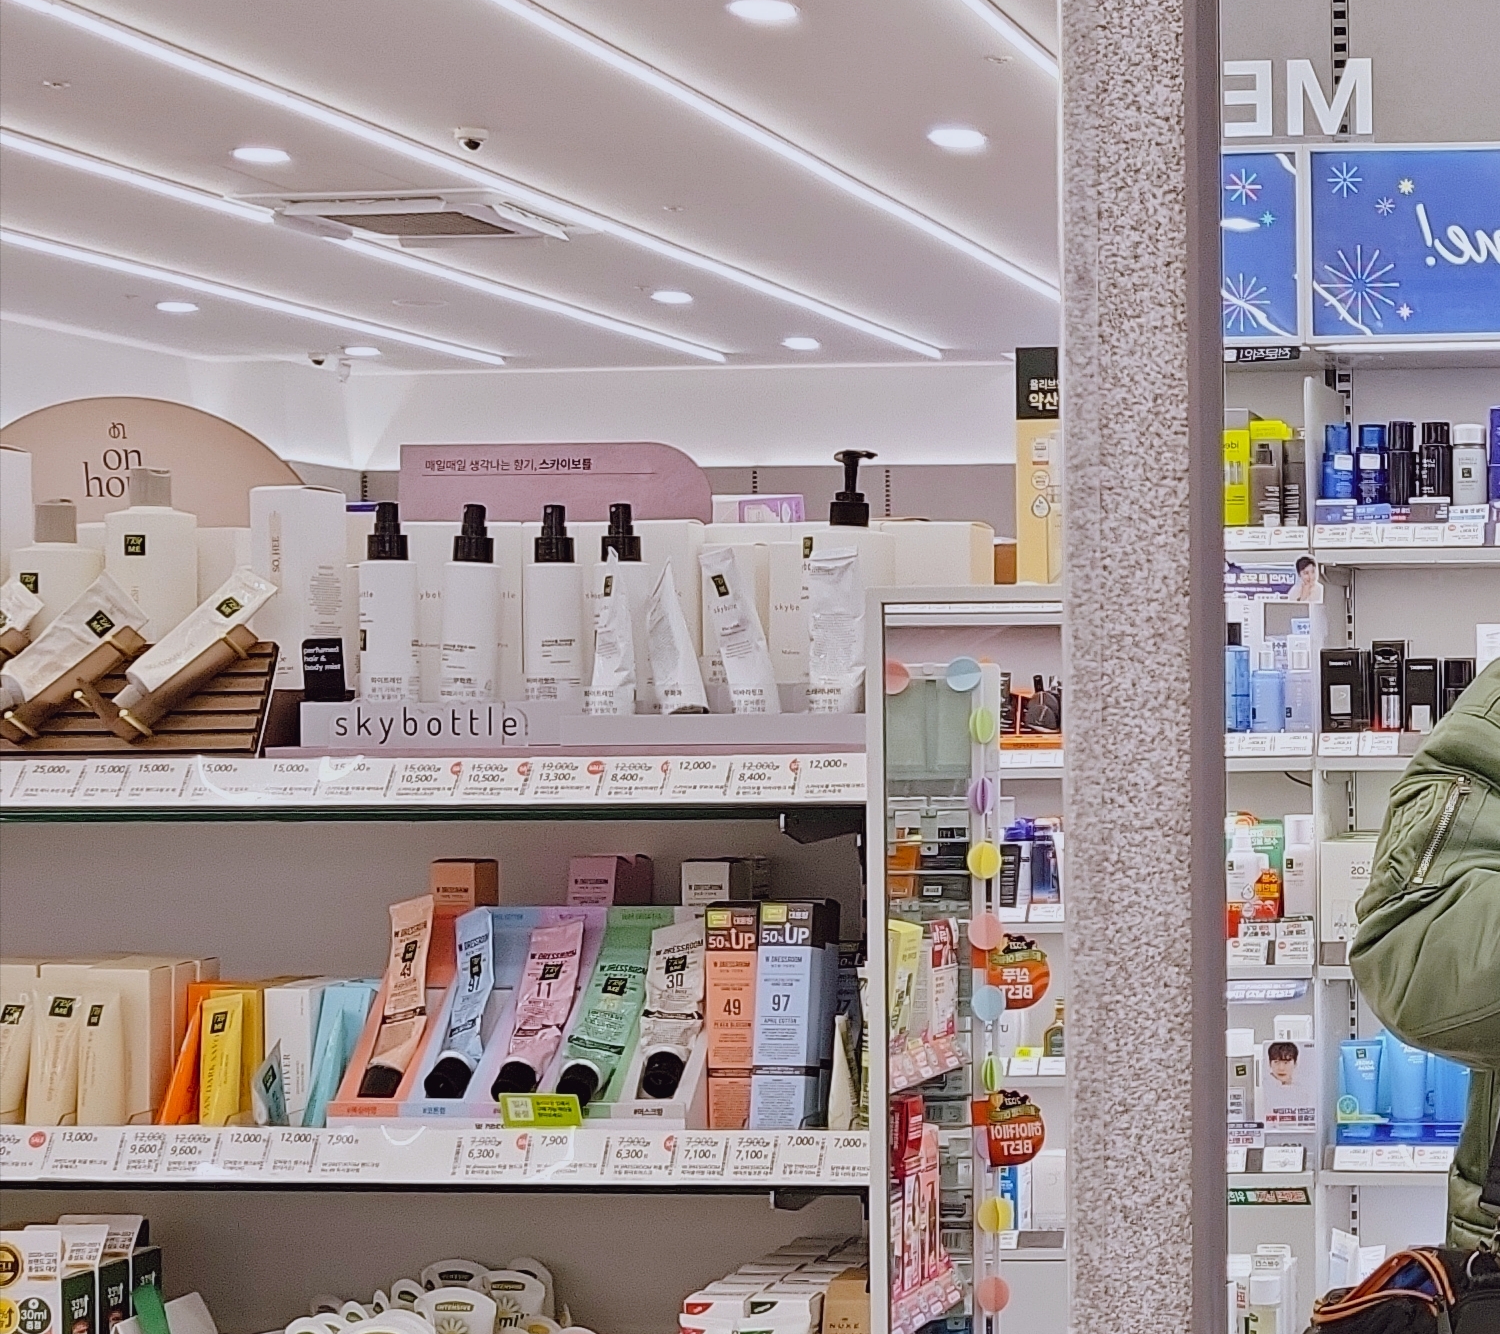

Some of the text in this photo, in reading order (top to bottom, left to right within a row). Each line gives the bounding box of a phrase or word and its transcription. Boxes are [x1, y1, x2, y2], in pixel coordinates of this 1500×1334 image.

[103, 449, 142, 470] on
[425, 459, 466, 471] 매일매일
[470, 458, 510, 470] 생각나는
[83, 462, 130, 497] ho
[335, 707, 518, 745] skybottle
[731, 933, 755, 949] UP
[785, 928, 809, 944] UP
[536, 982, 552, 998] 11
[723, 999, 741, 1015] 49
[772, 994, 790, 1011] 97
[20, 1310, 47, 1320] 30ml
